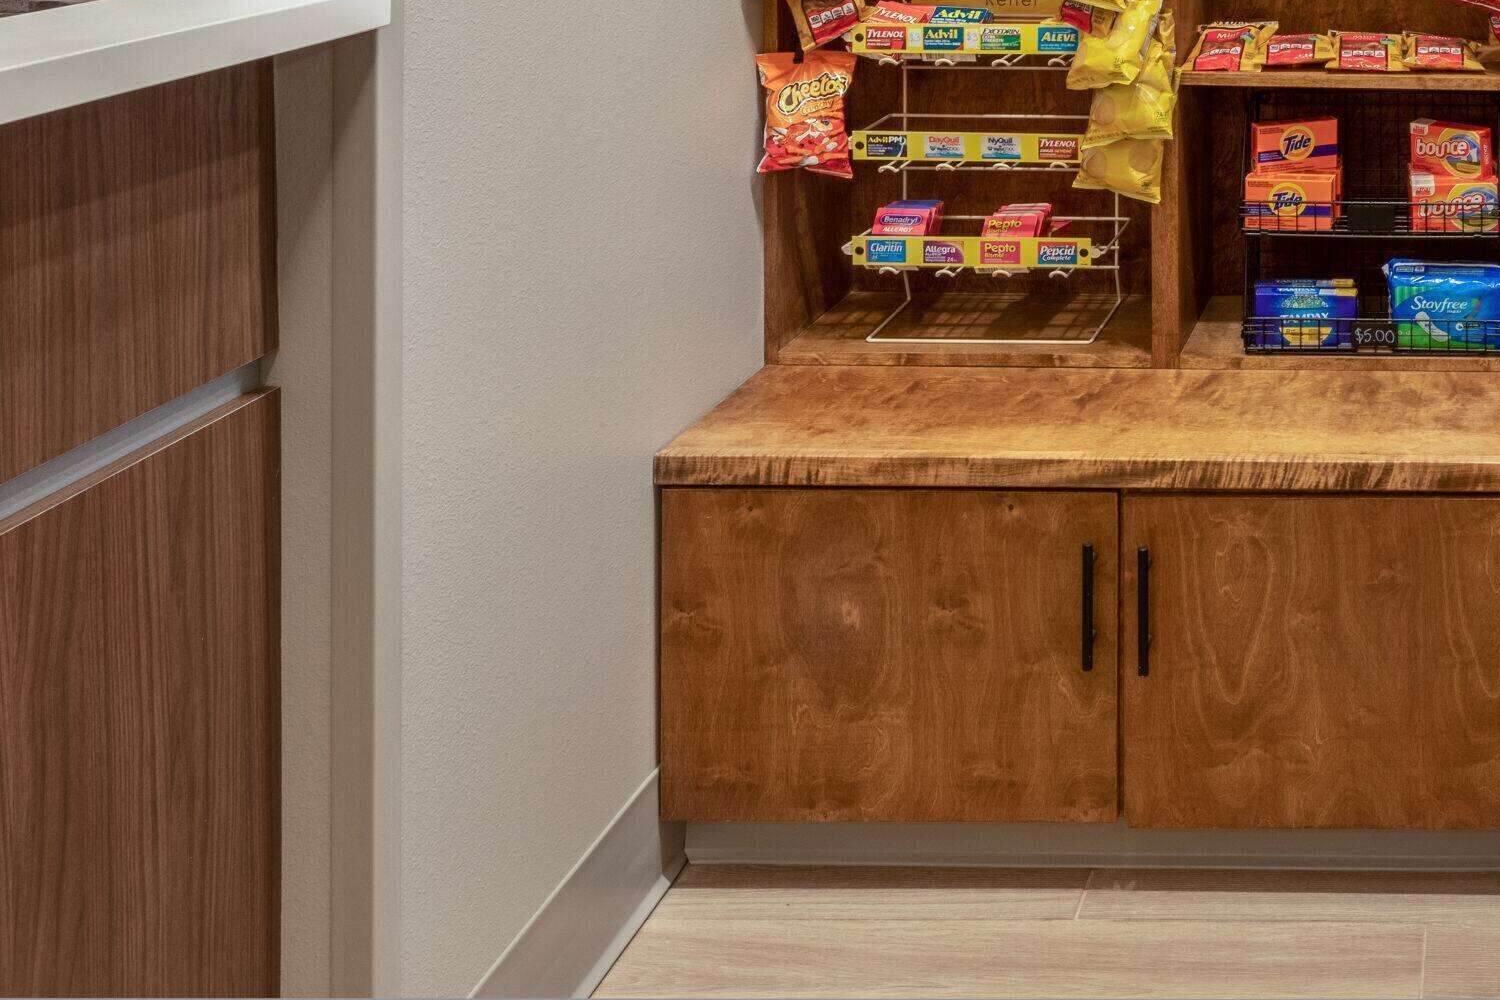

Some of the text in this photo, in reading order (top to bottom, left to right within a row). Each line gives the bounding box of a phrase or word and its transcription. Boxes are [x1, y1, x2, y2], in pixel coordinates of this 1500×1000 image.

[877, 7, 918, 24] TYLENOL
[936, 8, 982, 20] Advil
[867, 29, 904, 38] TYLENOL
[925, 29, 958, 40] Advil
[1041, 33, 1076, 42] ALEVE
[778, 72, 848, 114] Cheetos
[868, 136, 903, 144] Advil PM
[928, 136, 960, 144] DayQuil
[988, 137, 1013, 145] NyQuil
[1039, 139, 1077, 148] TYLENOL
[1283, 135, 1311, 155] Tide
[1416, 137, 1470, 158] bounce
[1273, 192, 1303, 210] Tide
[884, 216, 918, 225] Benadryl
[989, 219, 1022, 228] Pepto
[870, 242, 903, 252] Claritin
[925, 245, 956, 255] Allegra
[985, 242, 1016, 253] Pepto
[1040, 245, 1075, 255] Pepcid
[1411, 295, 1468, 313] Stayfree
[1354, 328, 1396, 345] $5.00
